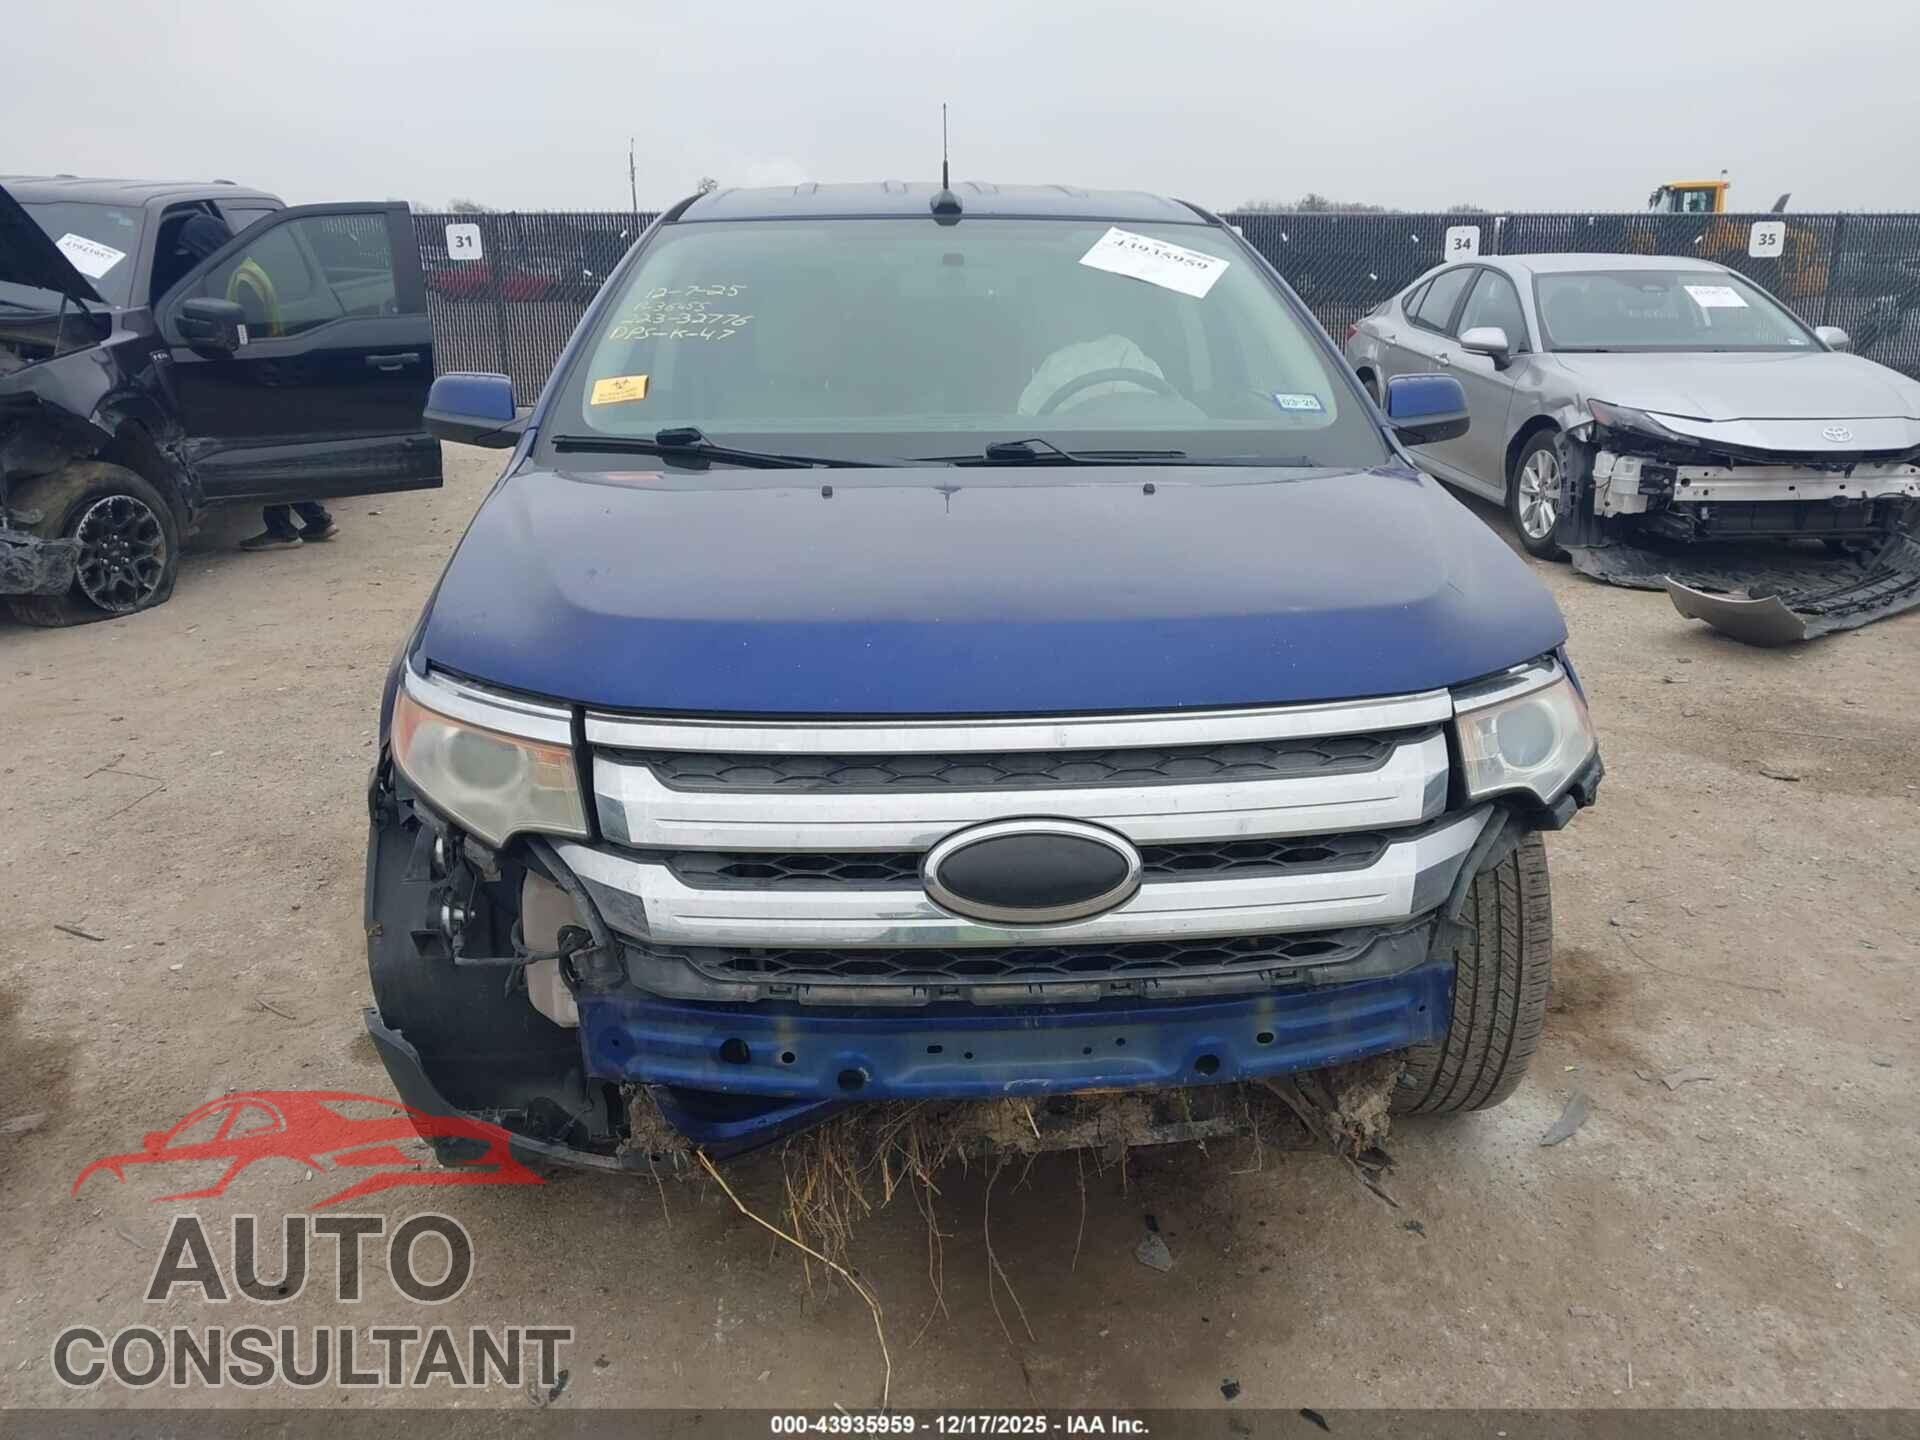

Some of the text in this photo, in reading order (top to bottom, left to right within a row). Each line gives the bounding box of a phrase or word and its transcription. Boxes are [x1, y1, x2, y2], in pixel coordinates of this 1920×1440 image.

[455, 235, 472, 248] 31
[1454, 238, 1472, 250] 34
[1758, 233, 1777, 246] 35
